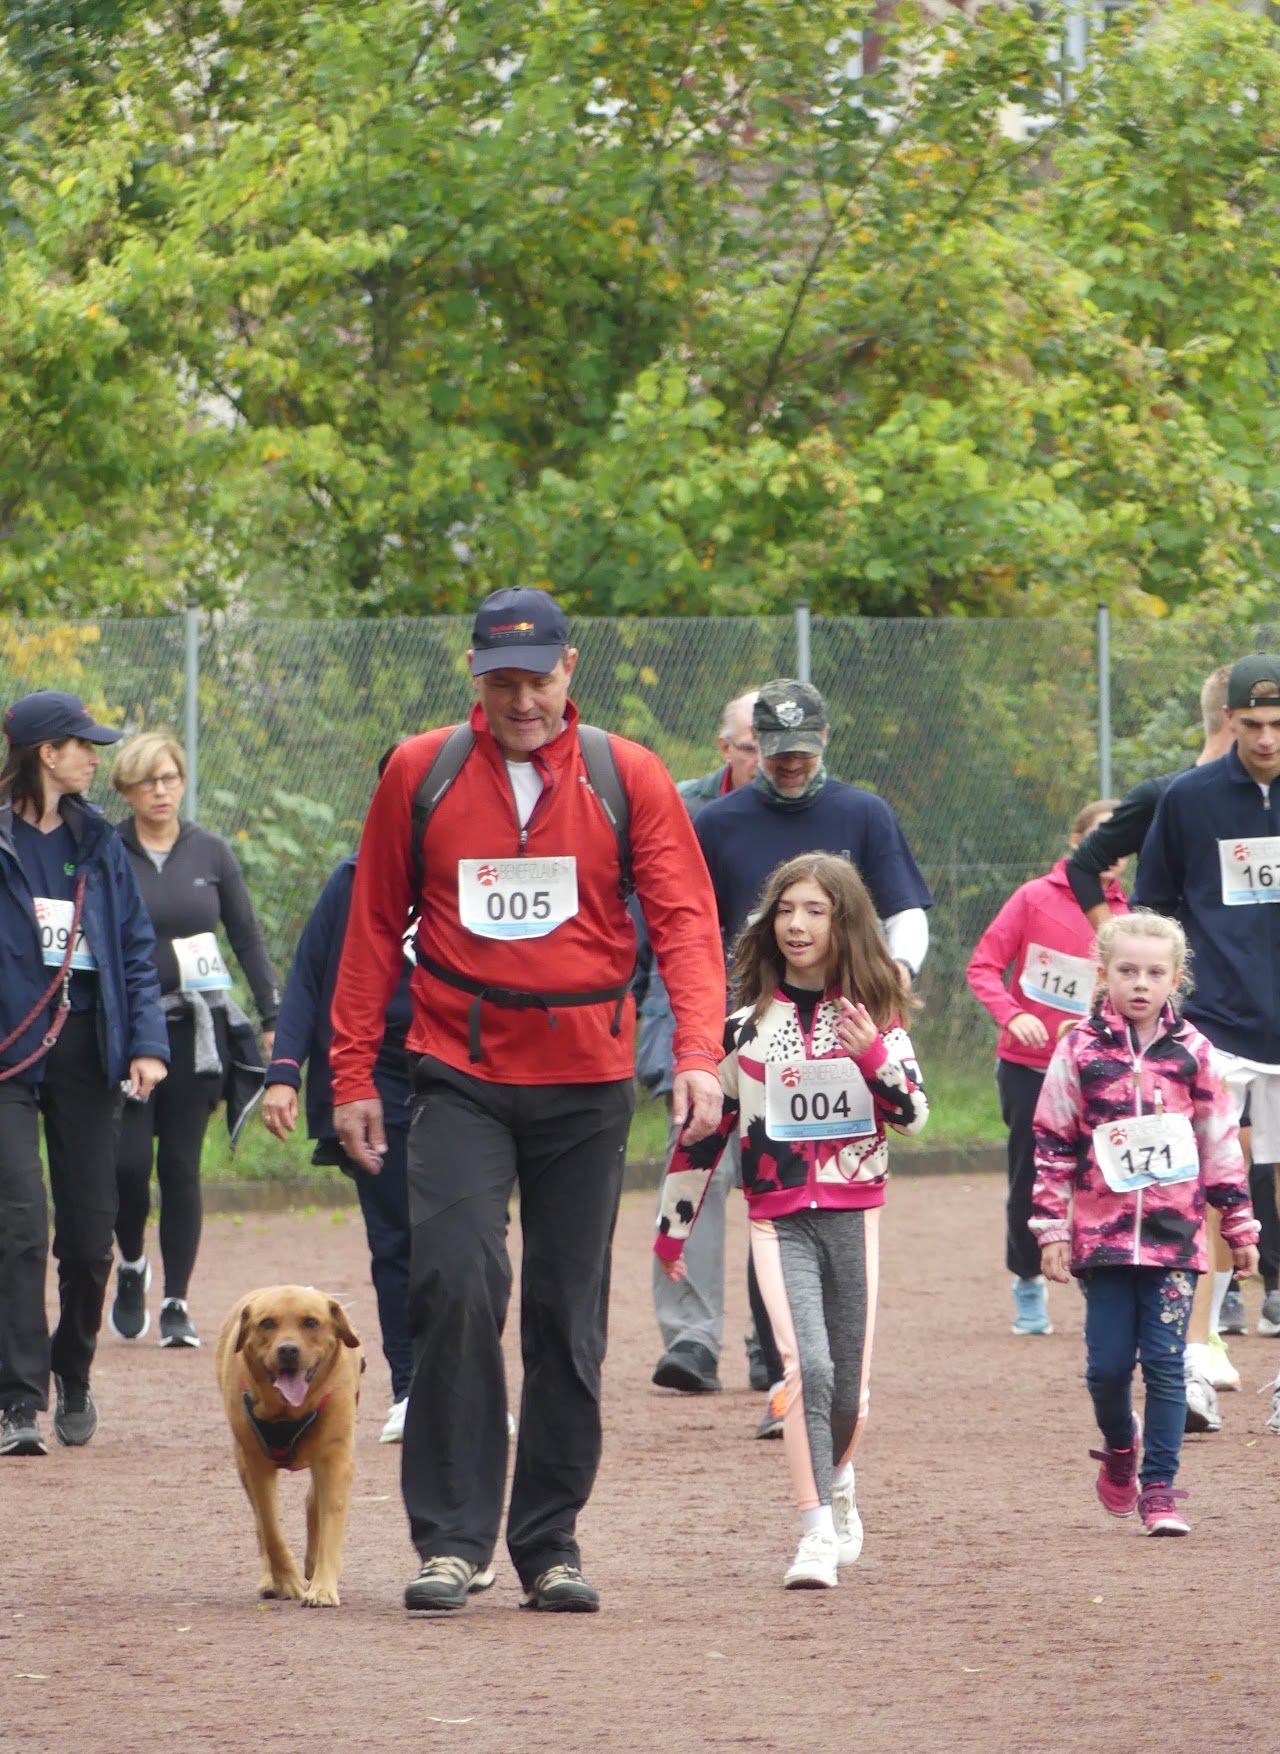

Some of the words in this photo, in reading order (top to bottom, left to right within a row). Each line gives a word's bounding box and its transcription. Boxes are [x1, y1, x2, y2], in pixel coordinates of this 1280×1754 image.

[487, 891, 551, 921] 005
[42, 926, 86, 952] 097
[197, 956, 222, 976] 04
[1041, 971, 1077, 999] 114
[790, 1090, 851, 1122] 004
[1120, 1143, 1171, 1174] 171
